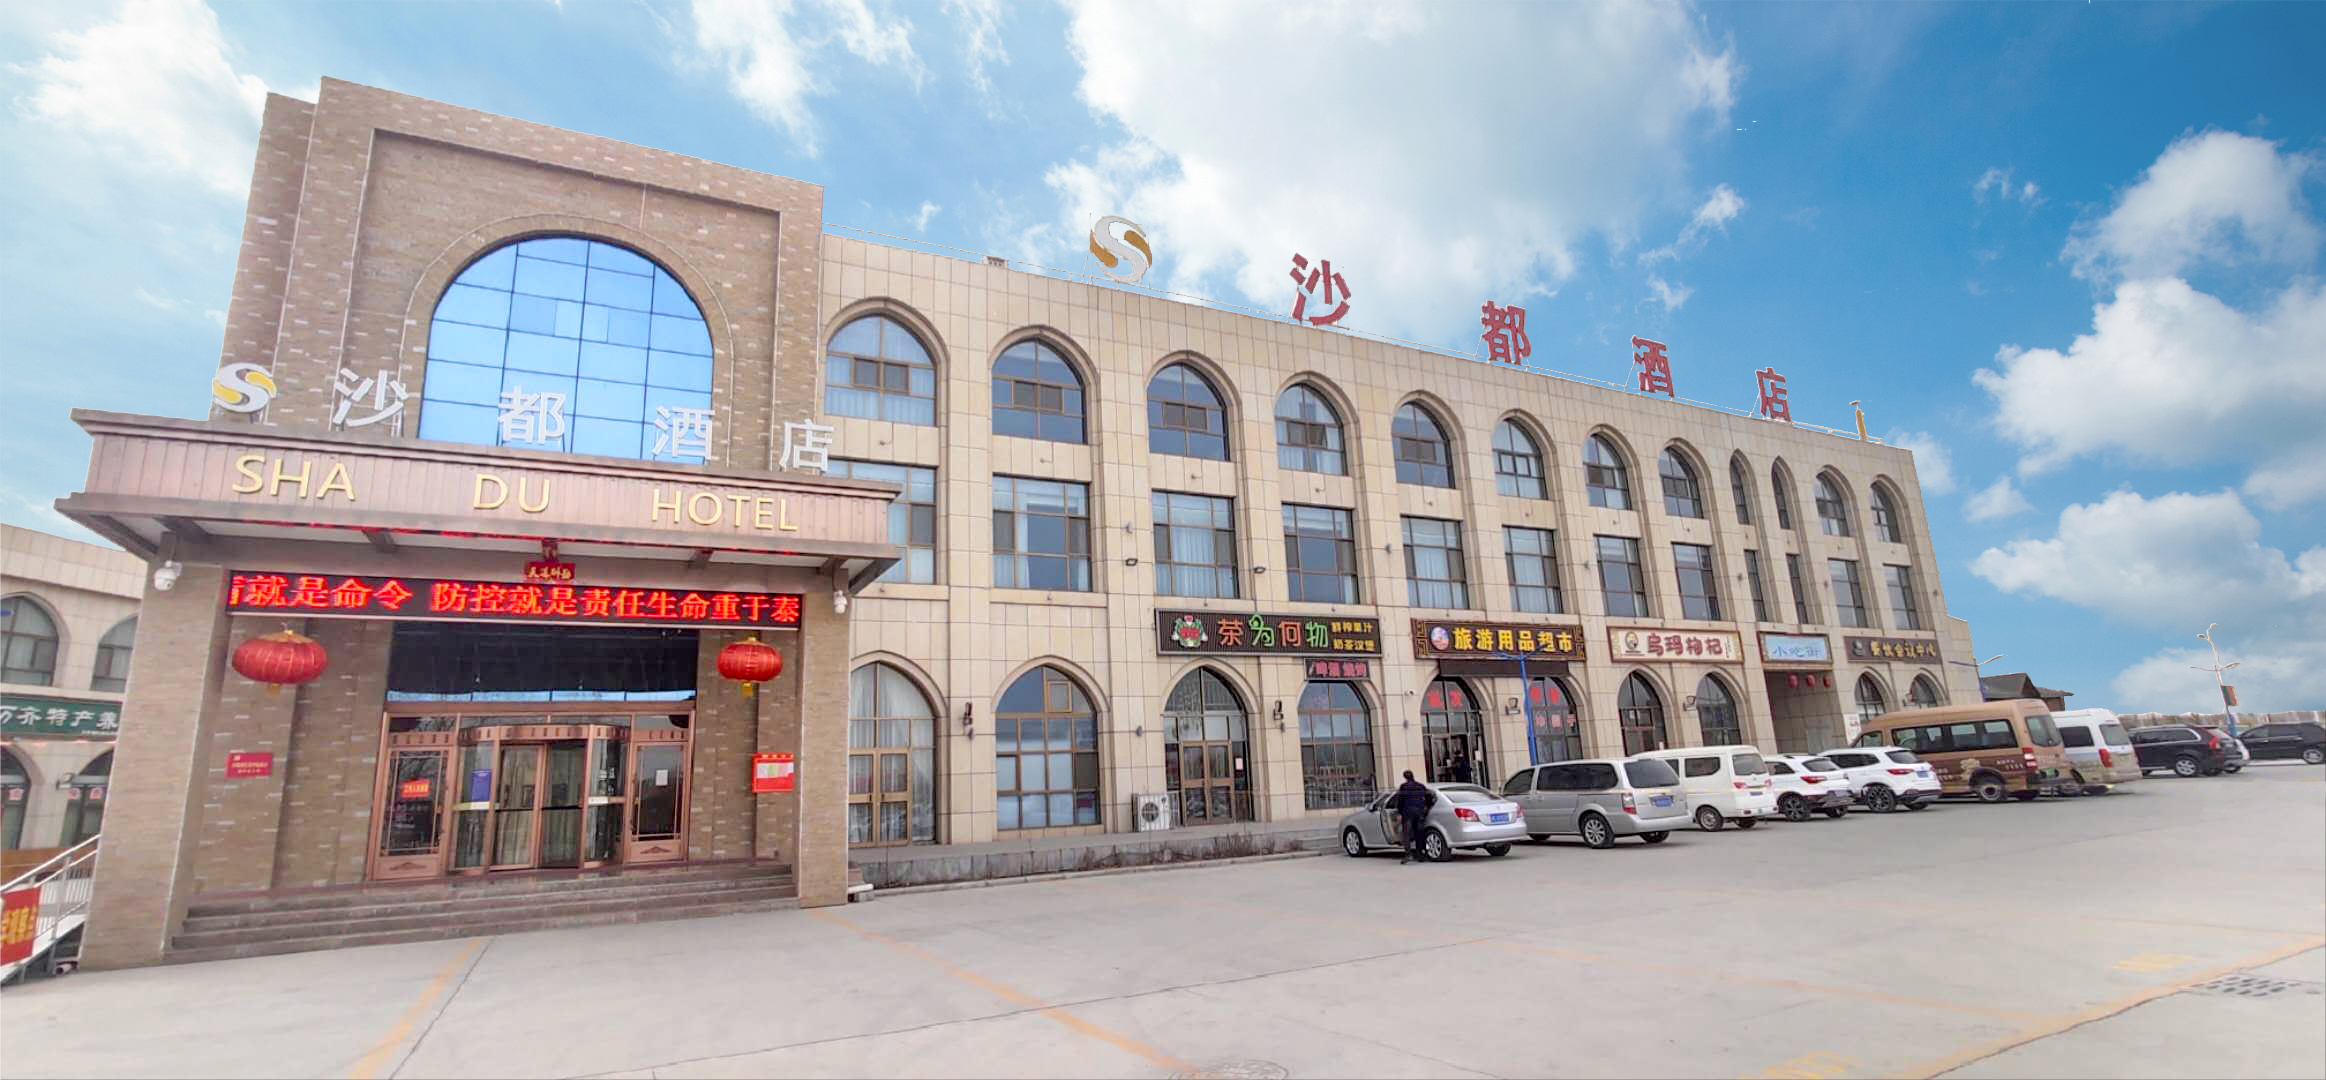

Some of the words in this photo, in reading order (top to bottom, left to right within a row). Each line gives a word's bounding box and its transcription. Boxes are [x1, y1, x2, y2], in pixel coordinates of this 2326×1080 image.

[1289, 252, 1791, 422] 沙都酒店
[333, 367, 835, 475] 沙都酒店
[231, 454, 356, 501] SHA
[472, 472, 552, 513] DU
[651, 488, 798, 532] HOTEL
[430, 581, 801, 623] 防控就是责任生命重于泰
[1452, 627, 1573, 653] 旅游用品超市
